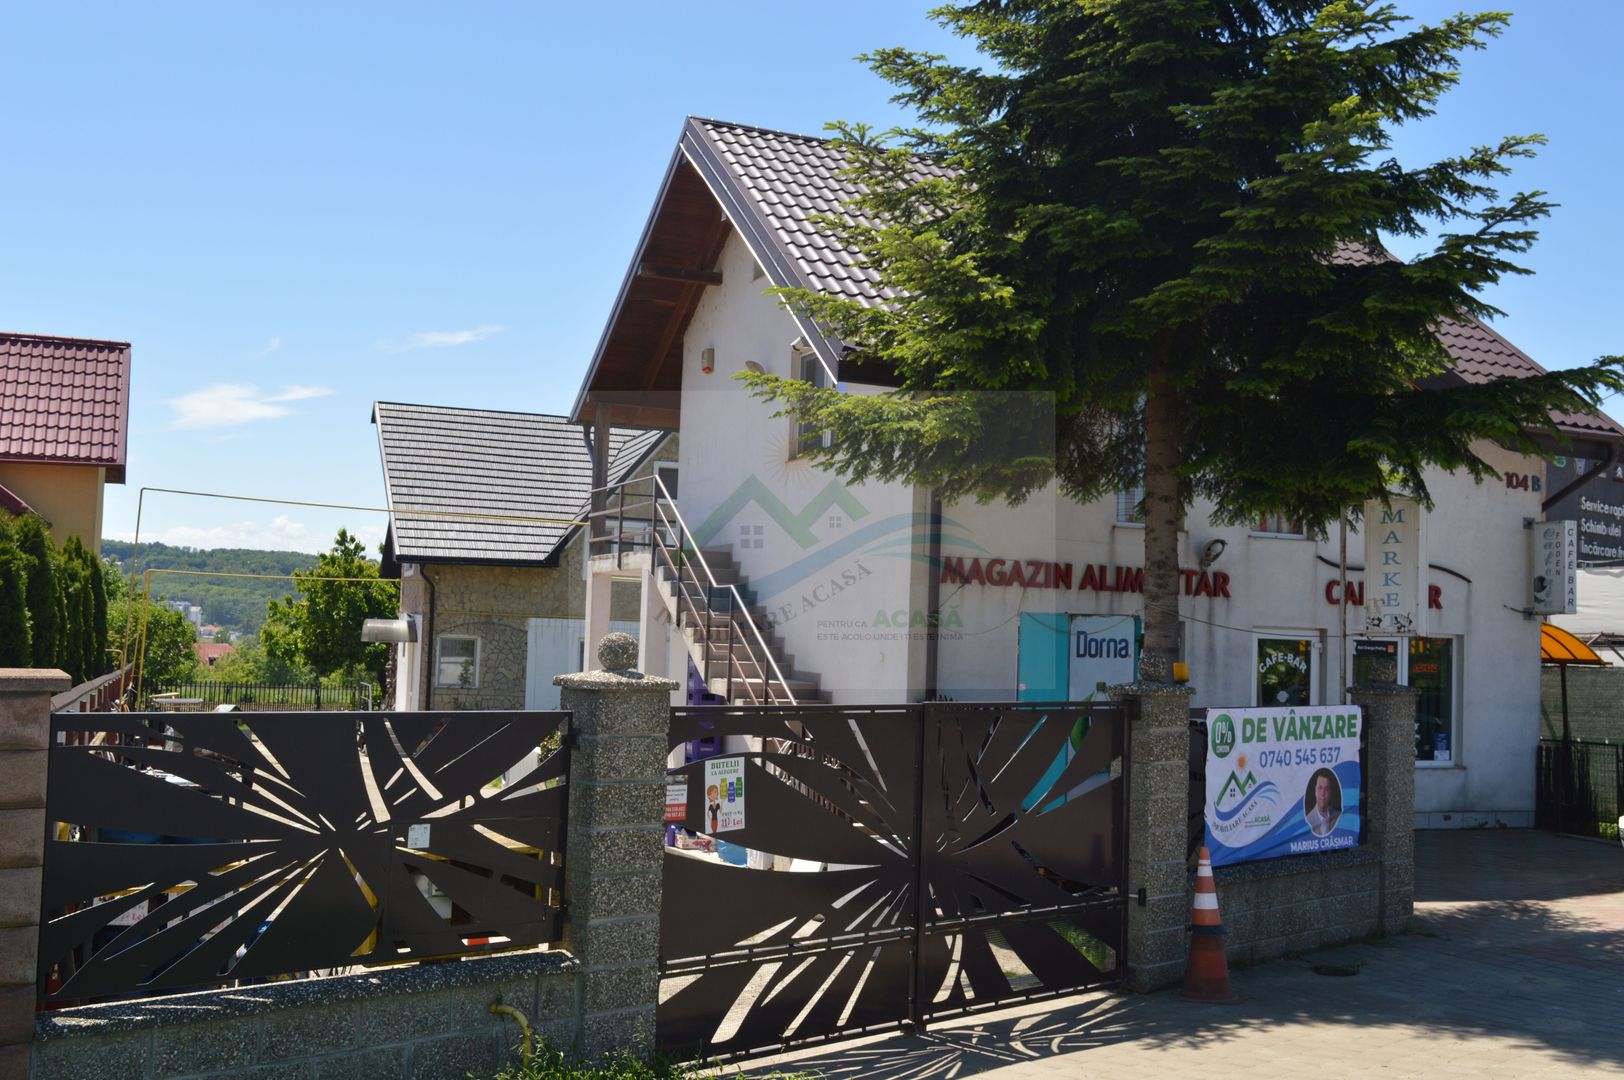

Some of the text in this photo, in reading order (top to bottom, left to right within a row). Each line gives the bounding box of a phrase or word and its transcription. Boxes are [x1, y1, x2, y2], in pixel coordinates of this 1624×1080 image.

[1504, 471, 1542, 492] 104 B
[1580, 496, 1609, 514] Service
[1580, 517, 1622, 538] Schimb ulei
[940, 556, 1231, 598] MAGAZIN ALIMTAR
[1379, 508, 1406, 628] MARKET
[1567, 576, 1575, 607] BAR
[1076, 630, 1130, 659] Dorna
[1215, 721, 1233, 744] 0%
[1241, 709, 1358, 744] DE VÂNZARE
[1259, 746, 1341, 768] 0740 545 637
[1290, 839, 1320, 853] MARIUS
